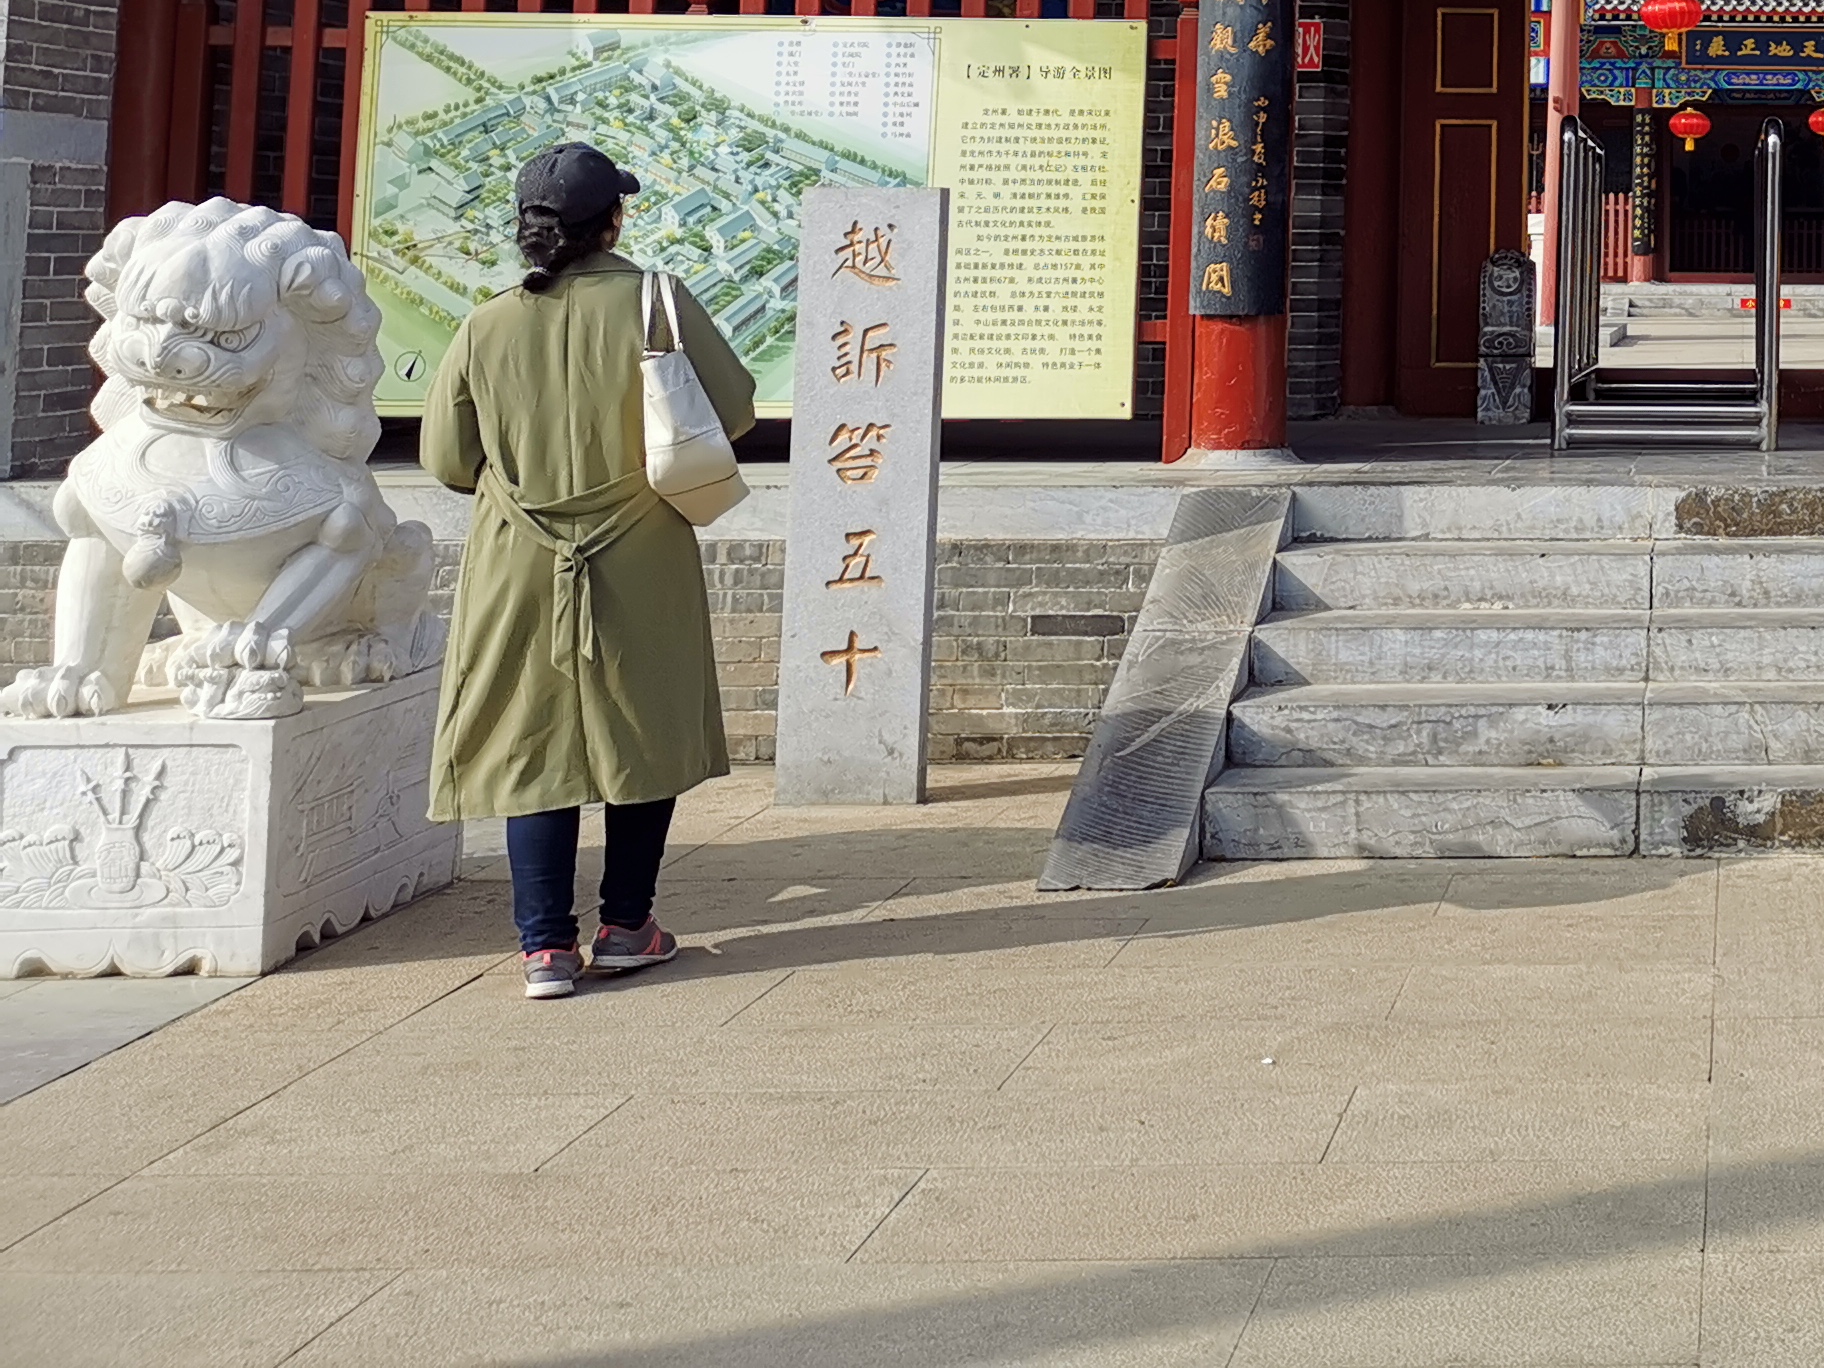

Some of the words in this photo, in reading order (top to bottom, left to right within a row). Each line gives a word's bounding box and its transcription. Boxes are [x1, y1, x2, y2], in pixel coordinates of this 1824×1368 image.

[966, 65, 1113, 81] 【定州署】导游全景图
[821, 220, 902, 698] 越訴笞五十
